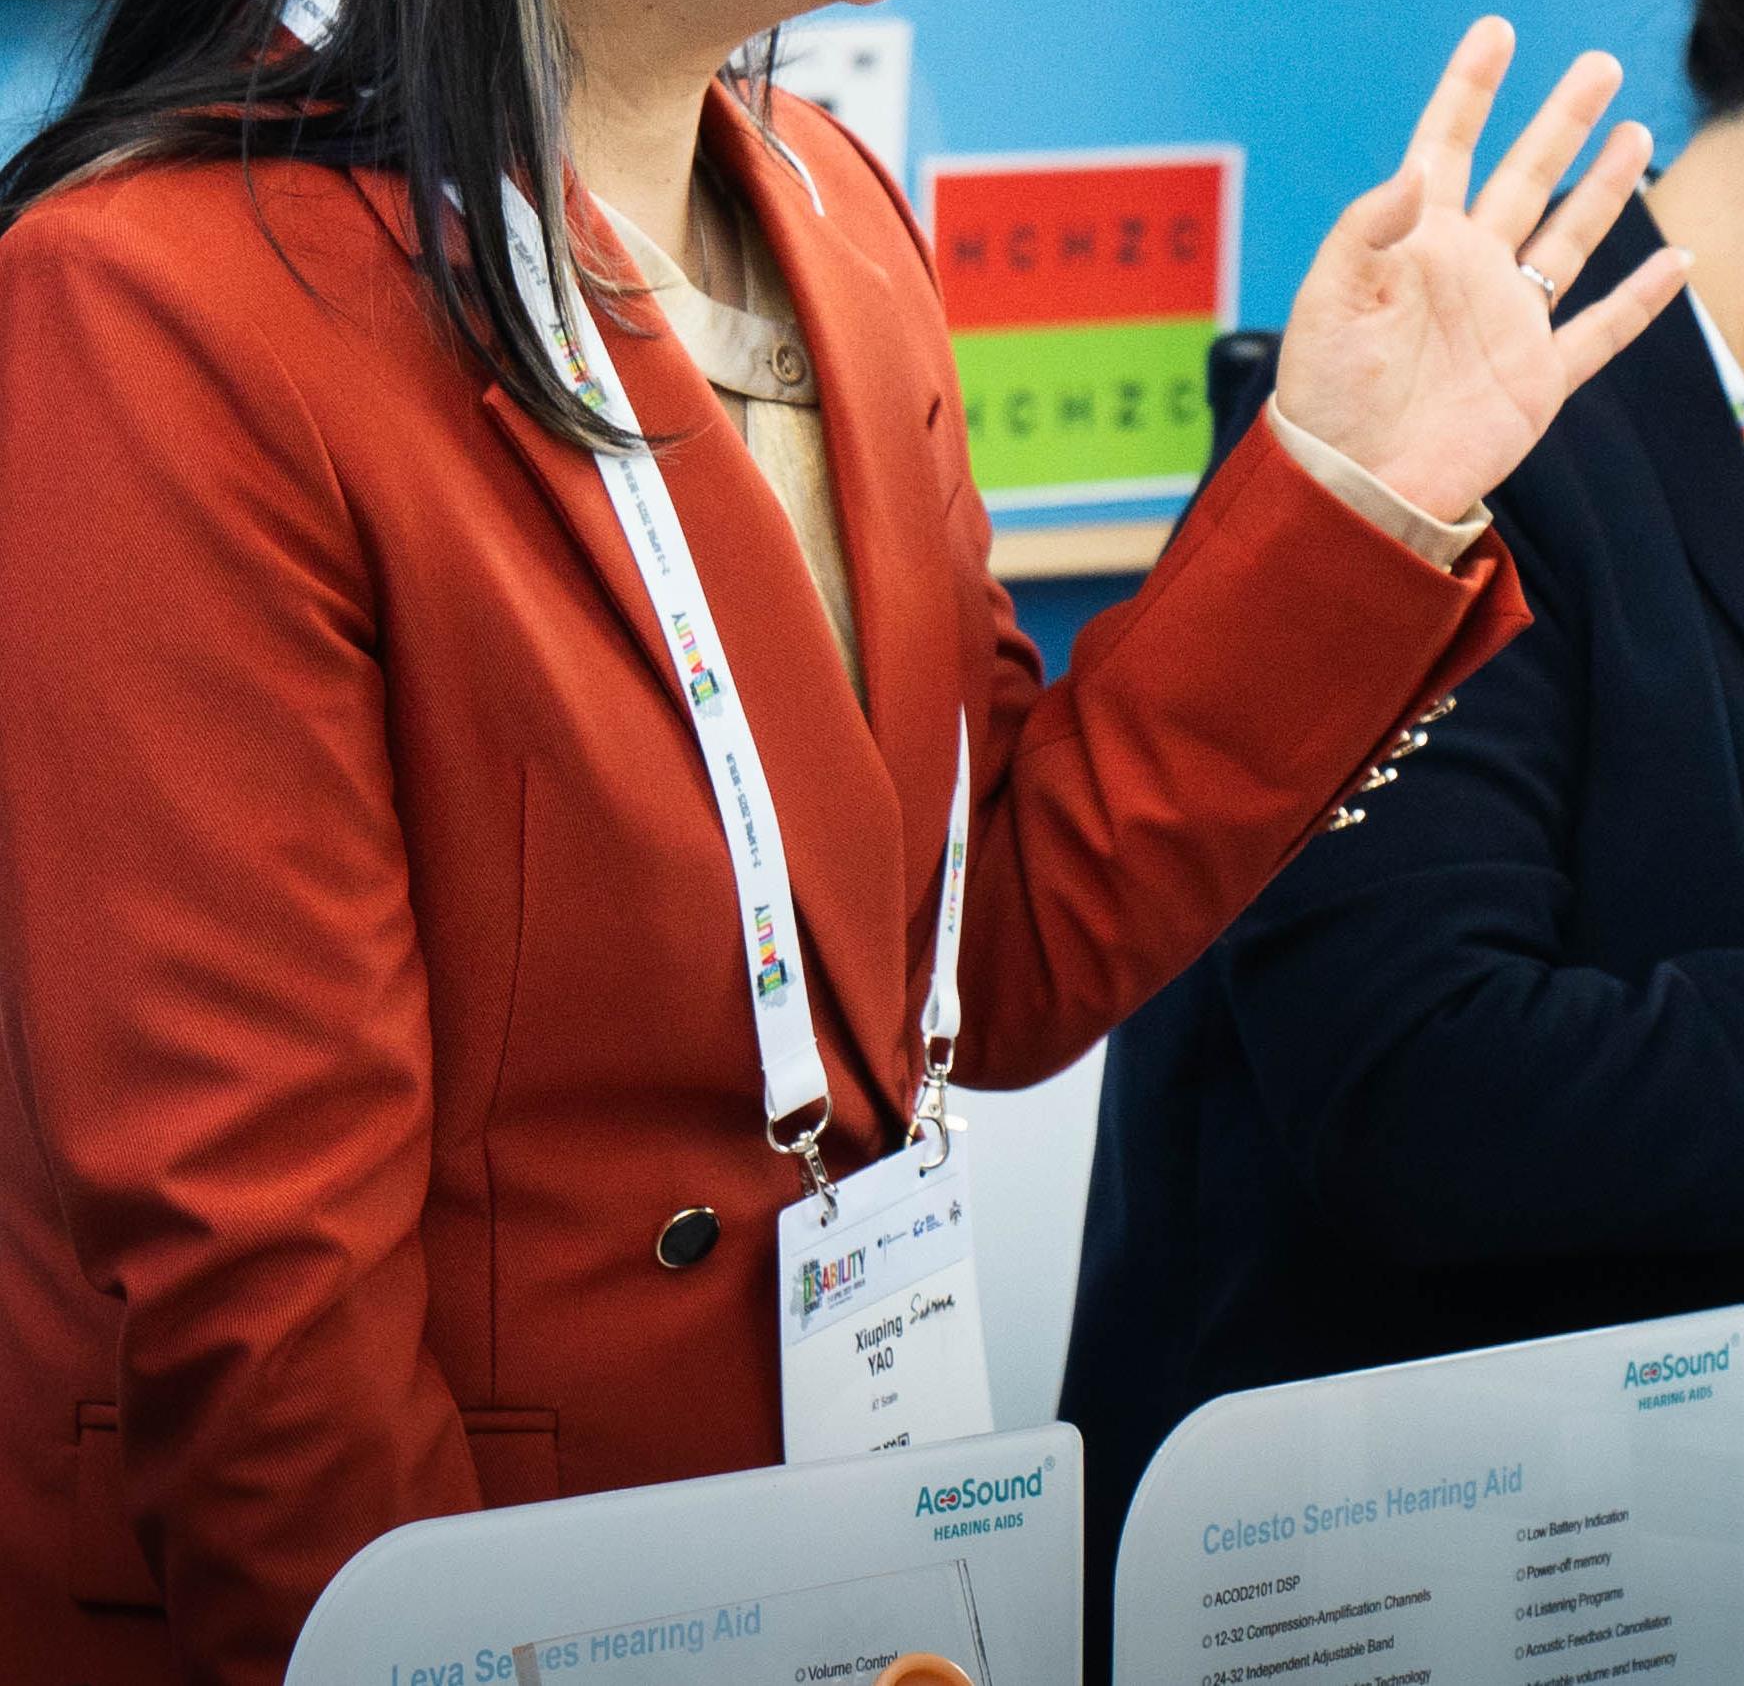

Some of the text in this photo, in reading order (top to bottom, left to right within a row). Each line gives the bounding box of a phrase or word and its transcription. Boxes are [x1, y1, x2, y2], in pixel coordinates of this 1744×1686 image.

[803, 1246, 866, 1305] DISABILITY
[855, 1315, 903, 1354] Xiuping
[868, 1346, 894, 1377] YAO
[1624, 1342, 1729, 1389] AcoSound
[1638, 1385, 1713, 1411] HEARING AIDS
[915, 1466, 1042, 1517] AcoSound
[1203, 1464, 1522, 1554] Celesto Series Hearing Aid
[934, 1513, 1023, 1541] HEARING AIDS
[1527, 1510, 1629, 1541] Low Battery Indication
[1527, 1552, 1612, 1580] Power-off memory
[1214, 1575, 1300, 1606] ACOD2101 DSP
[1535, 1598, 1577, 1618] Listening
[1578, 1588, 1624, 1607] Programs
[590, 1619, 704, 1663] Hearing
[713, 1602, 762, 1641] Aid
[1214, 1588, 1431, 1646] 12-32 Compression-Amplification Channels
[1525, 1615, 1672, 1658] Acoustic Feedback Cancellation
[808, 1662, 852, 1681] Volume
[1213, 1635, 1394, 1686] 24-32 Independent Adjustable Band
[1577, 1667, 1610, 1684] volume
[1612, 1660, 1630, 1677] and
[1632, 1652, 1678, 1674] frequency
